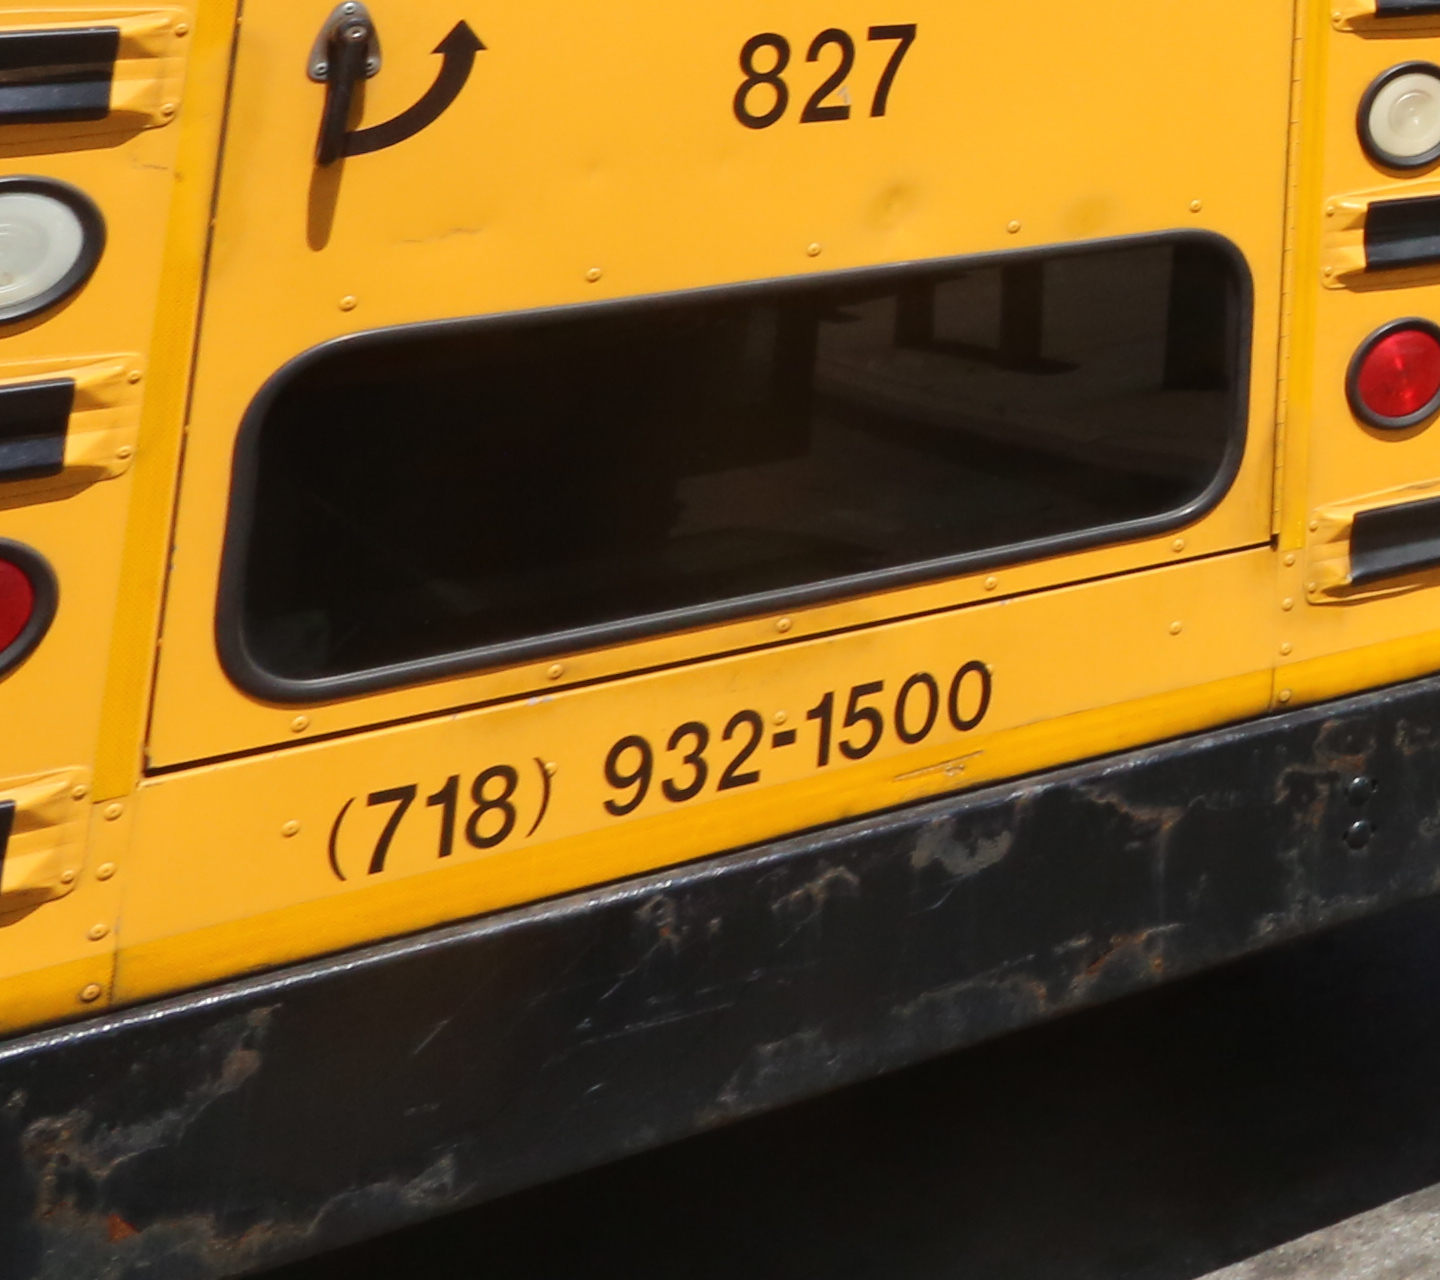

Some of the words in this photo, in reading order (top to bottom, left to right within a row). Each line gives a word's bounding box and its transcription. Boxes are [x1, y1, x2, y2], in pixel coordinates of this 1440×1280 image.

[732, 23, 919, 130] 827
[328, 757, 553, 881] (718)
[601, 660, 993, 816] 932-1500
